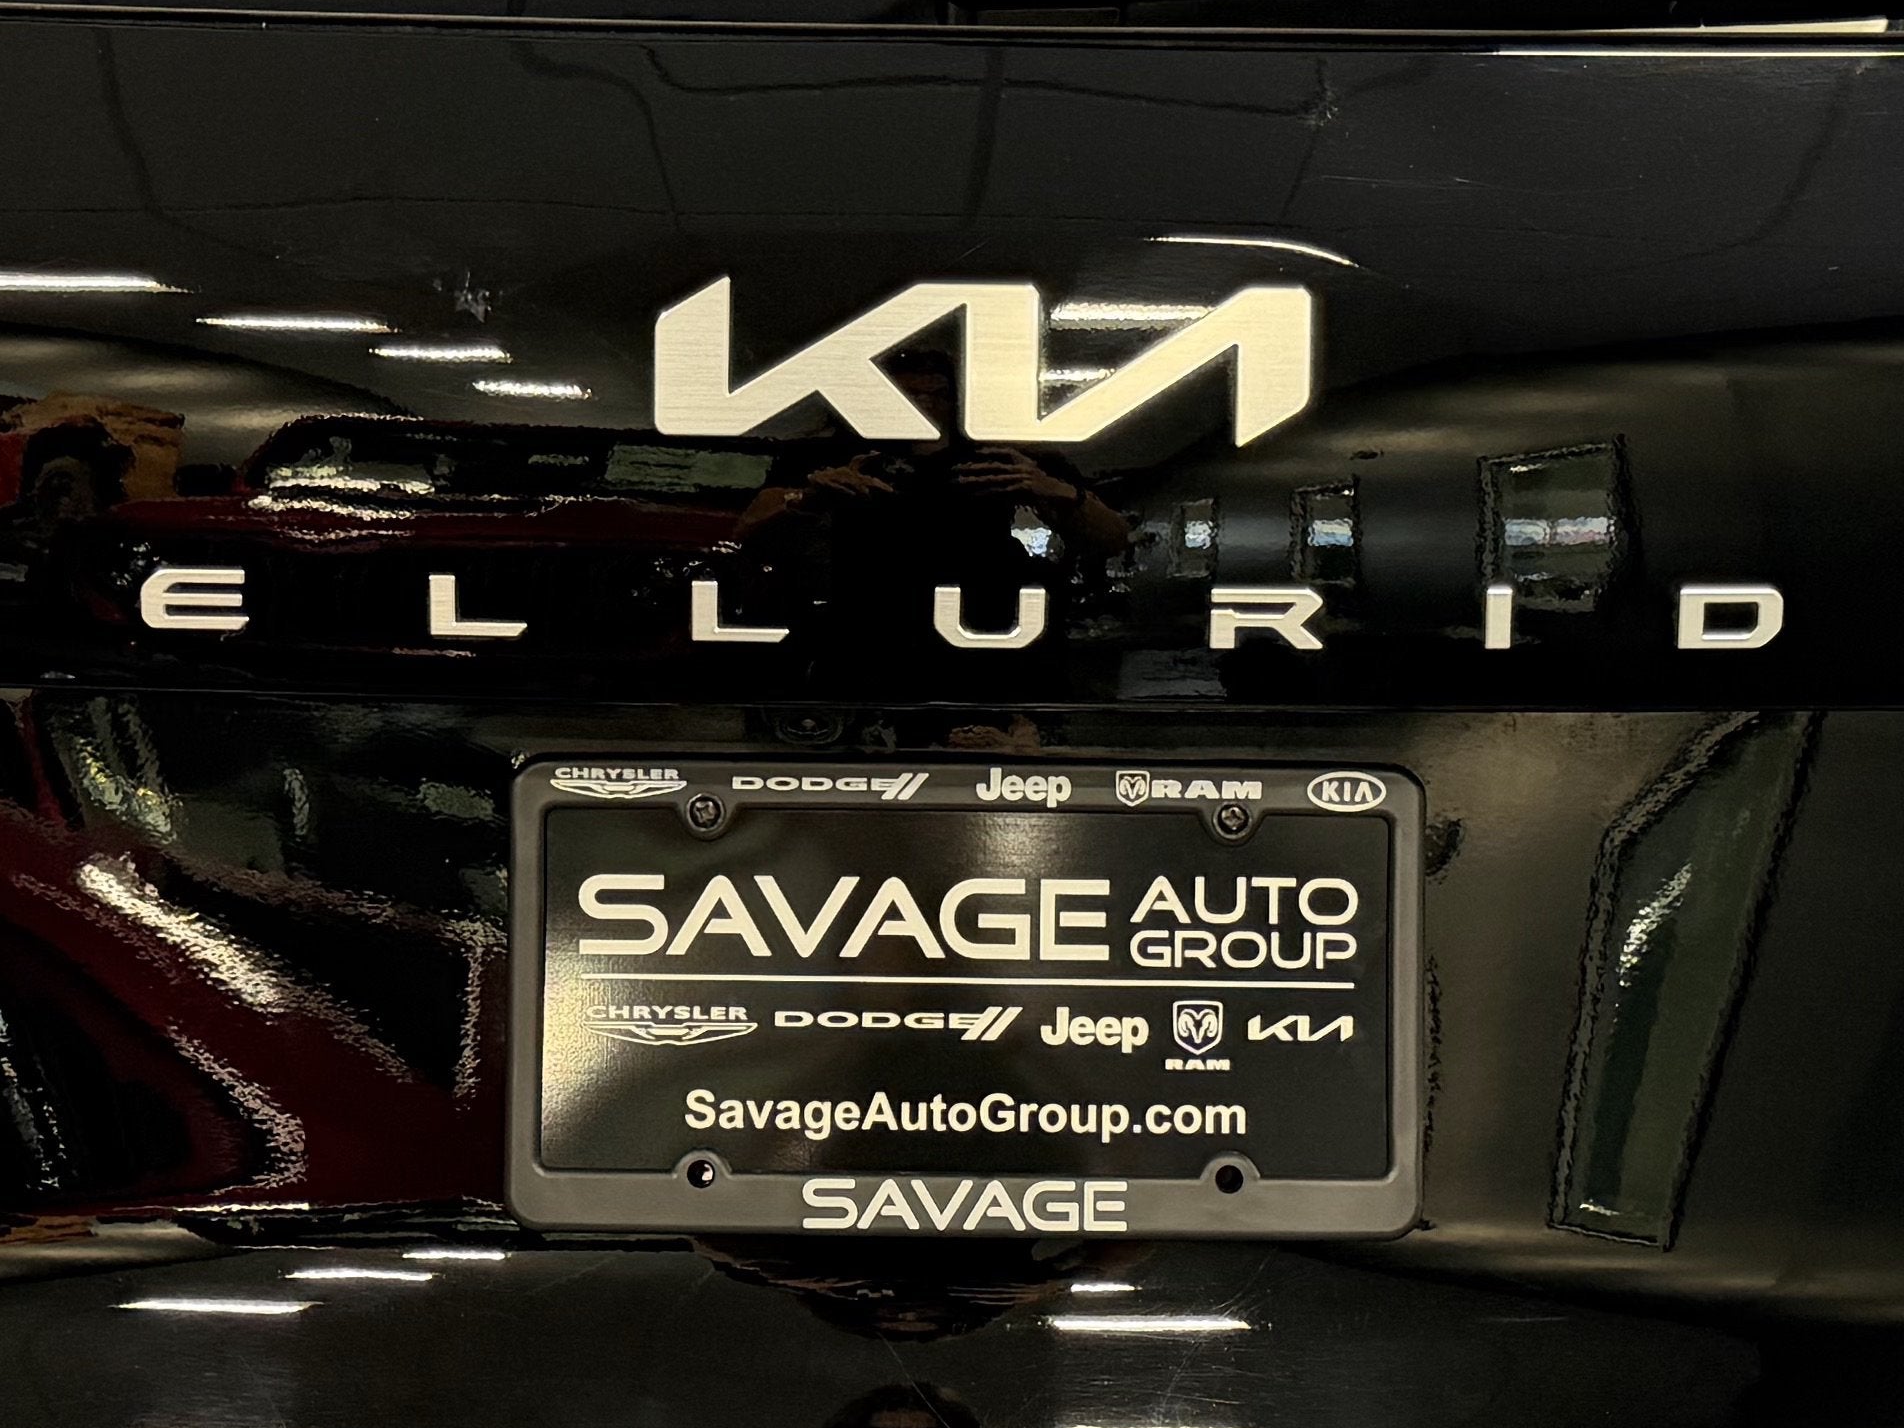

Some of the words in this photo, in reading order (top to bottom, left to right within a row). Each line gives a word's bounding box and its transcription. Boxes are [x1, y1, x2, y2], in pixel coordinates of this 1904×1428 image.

[655, 276, 1313, 447] KIA
[555, 767, 679, 780] CHRYSLER
[732, 775, 902, 793] DODGE
[976, 767, 1072, 808] Jeep
[1151, 780, 1262, 800] RAM
[578, 874, 1111, 961] SAVAGE
[1131, 876, 1359, 926] AUTO
[1130, 930, 1357, 970] GROUP
[587, 1006, 748, 1021] CHRYSLER
[774, 1010, 983, 1031] DODGE
[1041, 1007, 1149, 1054] Jeep
[1165, 1058, 1230, 1071] RAM
[684, 1089, 1248, 1144] SavageAutoGroup.com
[802, 1178, 1127, 1233] SAVAGE
